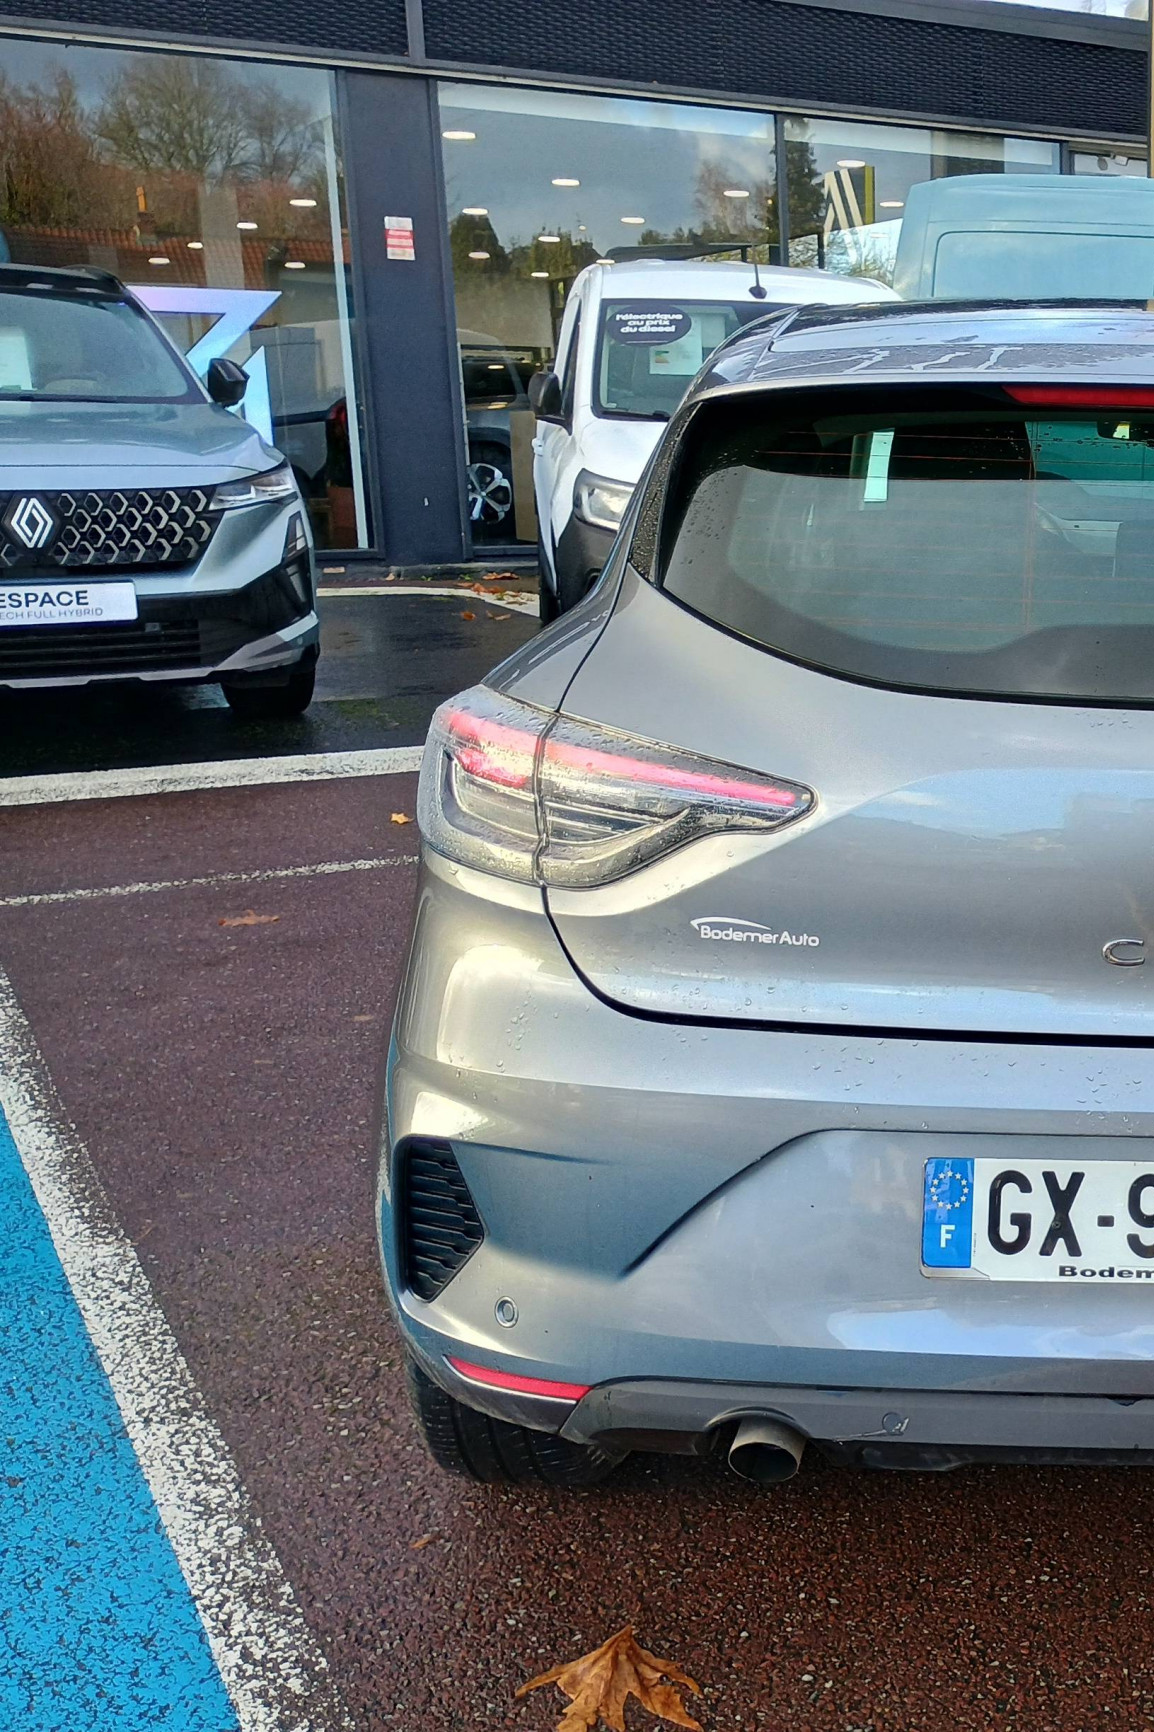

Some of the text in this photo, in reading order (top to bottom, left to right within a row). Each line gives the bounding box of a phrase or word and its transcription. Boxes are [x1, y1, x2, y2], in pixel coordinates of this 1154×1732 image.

[620, 324, 676, 333] du diesel
[27, 609, 56, 619] FULL
[58, 606, 104, 617] HYBRID
[940, 1224, 956, 1248] F
